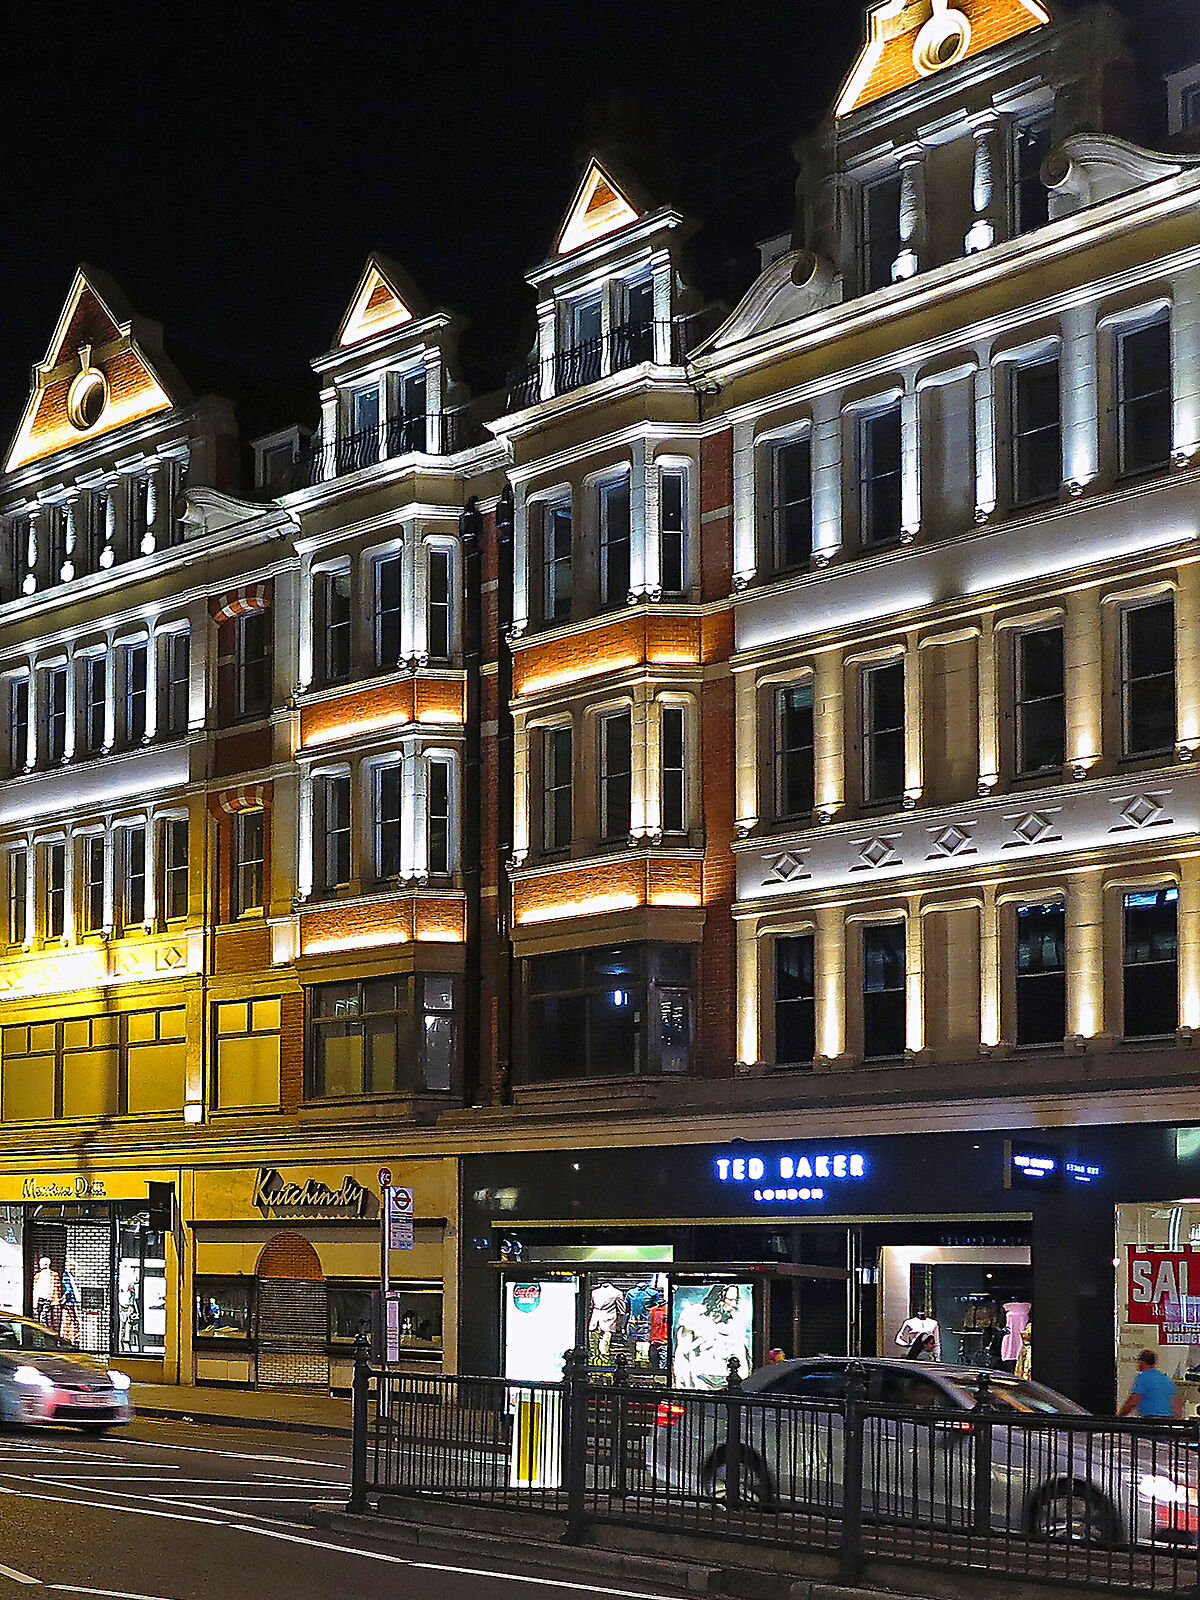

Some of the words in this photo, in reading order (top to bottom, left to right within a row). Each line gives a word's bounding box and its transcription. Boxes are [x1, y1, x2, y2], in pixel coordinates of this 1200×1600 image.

[716, 1157, 765, 1181] TED
[779, 1153, 865, 1179] BAKER
[252, 1167, 366, 1215] Kutchinsky
[753, 1187, 825, 1202] LONDON
